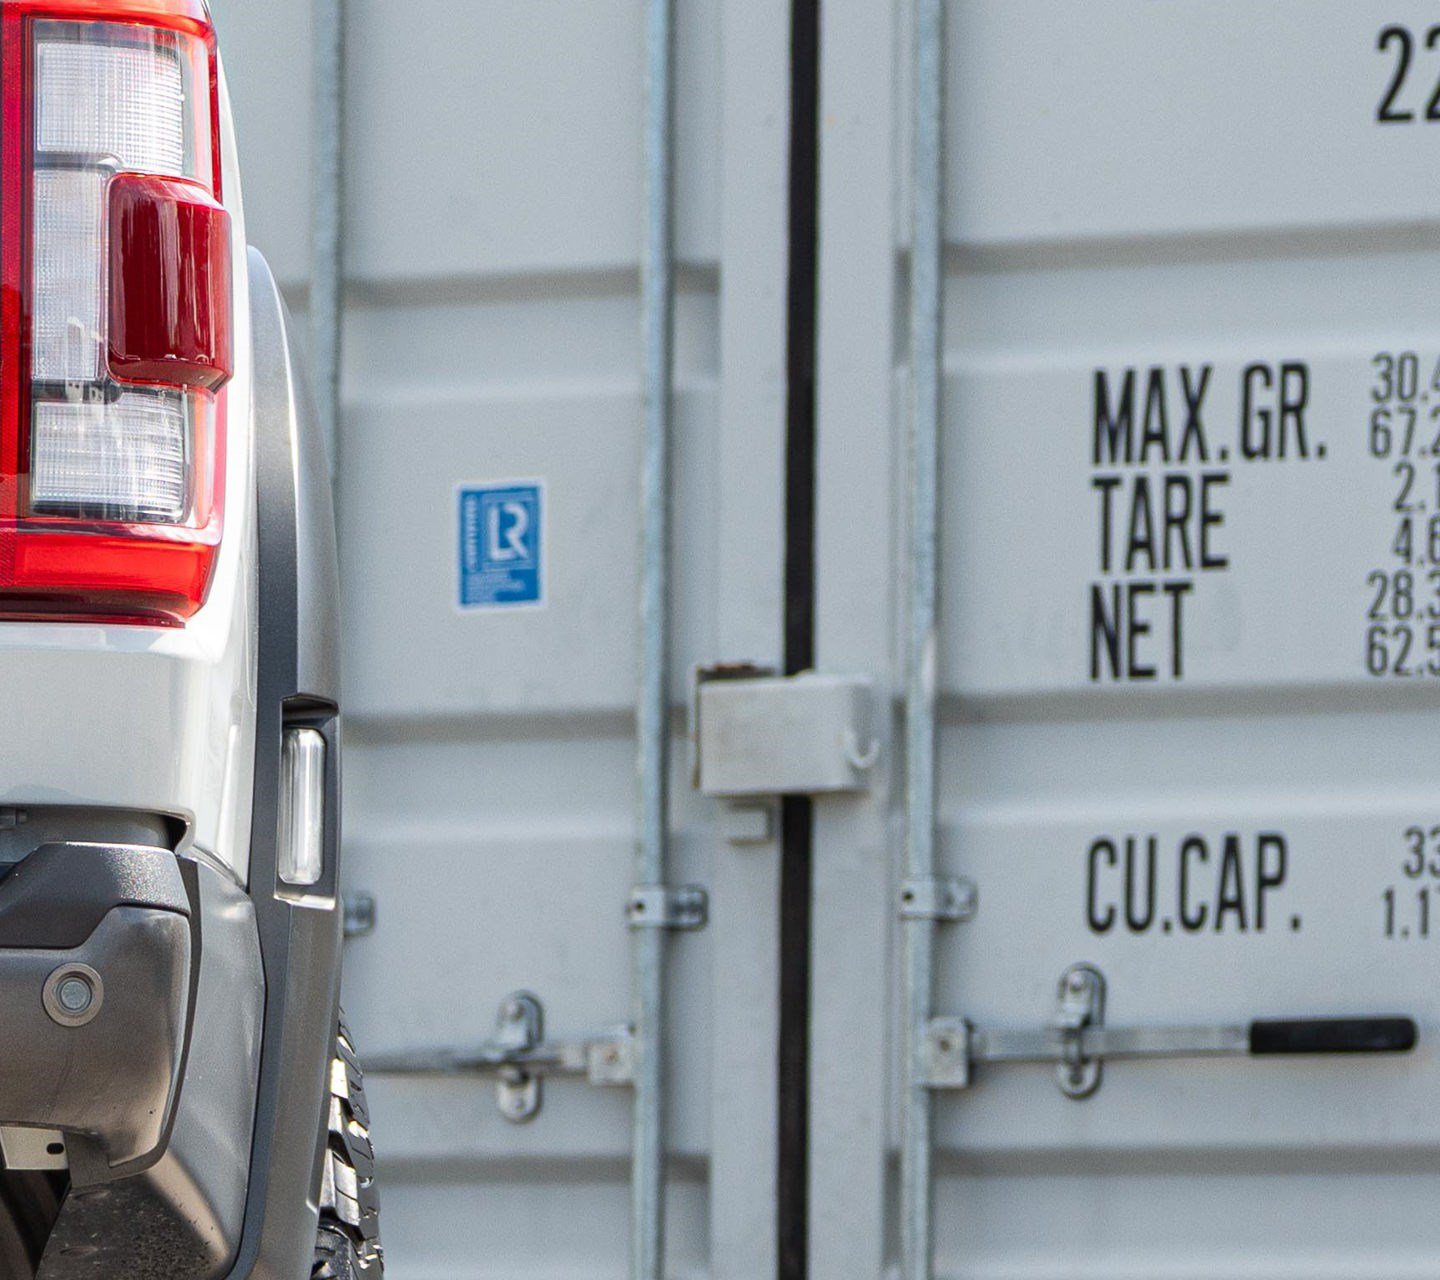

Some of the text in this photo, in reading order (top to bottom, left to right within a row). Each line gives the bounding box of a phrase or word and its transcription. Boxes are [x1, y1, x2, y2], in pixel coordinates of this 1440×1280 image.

[1091, 362, 1327, 464] MAX.GR.
[1091, 474, 1230, 572] TARE
[1091, 580, 1194, 680] NET
[1087, 832, 1302, 934] CU.CAP.
